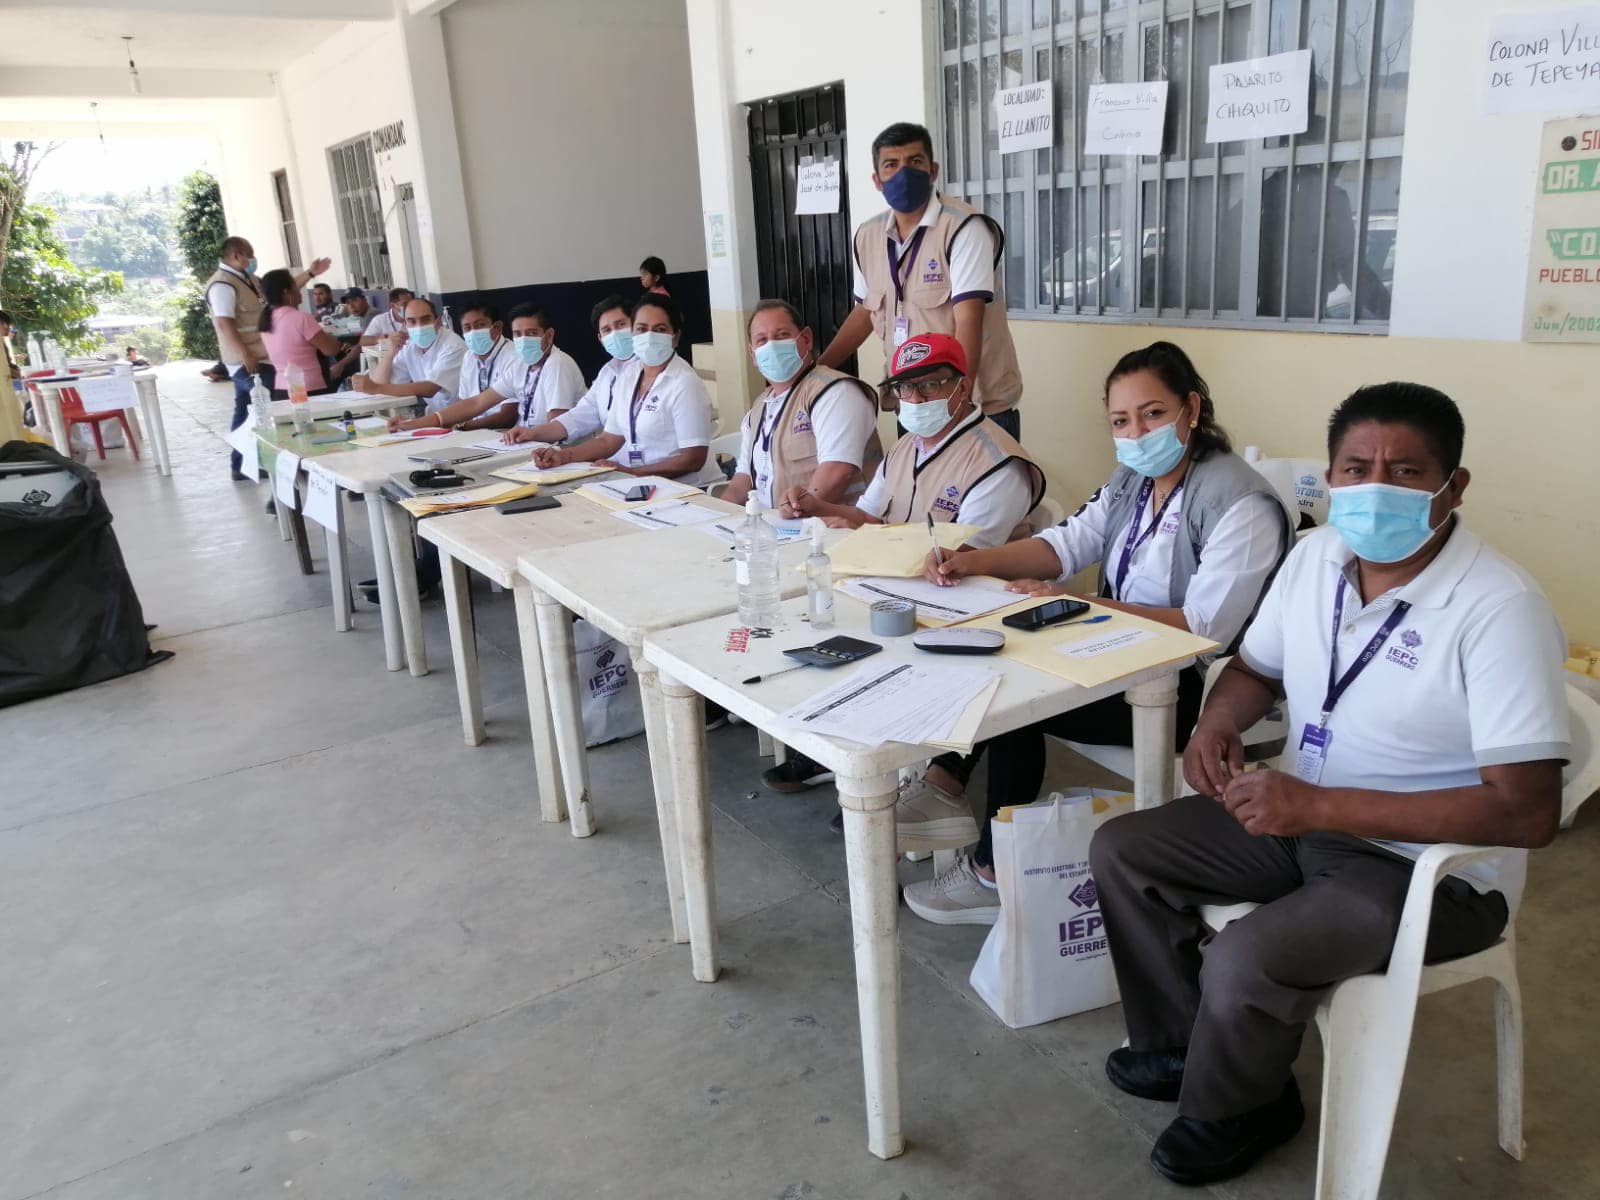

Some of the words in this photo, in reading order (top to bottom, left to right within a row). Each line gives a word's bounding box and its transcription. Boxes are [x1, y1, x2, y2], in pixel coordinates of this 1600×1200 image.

[1491, 71, 1513, 88] DE
[1216, 98, 1291, 119] CHIQUITO
[1015, 114, 1050, 136] LLANITO
[1546, 164, 1585, 190] DR.
[1387, 646, 1419, 666] IEPC
[588, 664, 627, 692] IEPC
